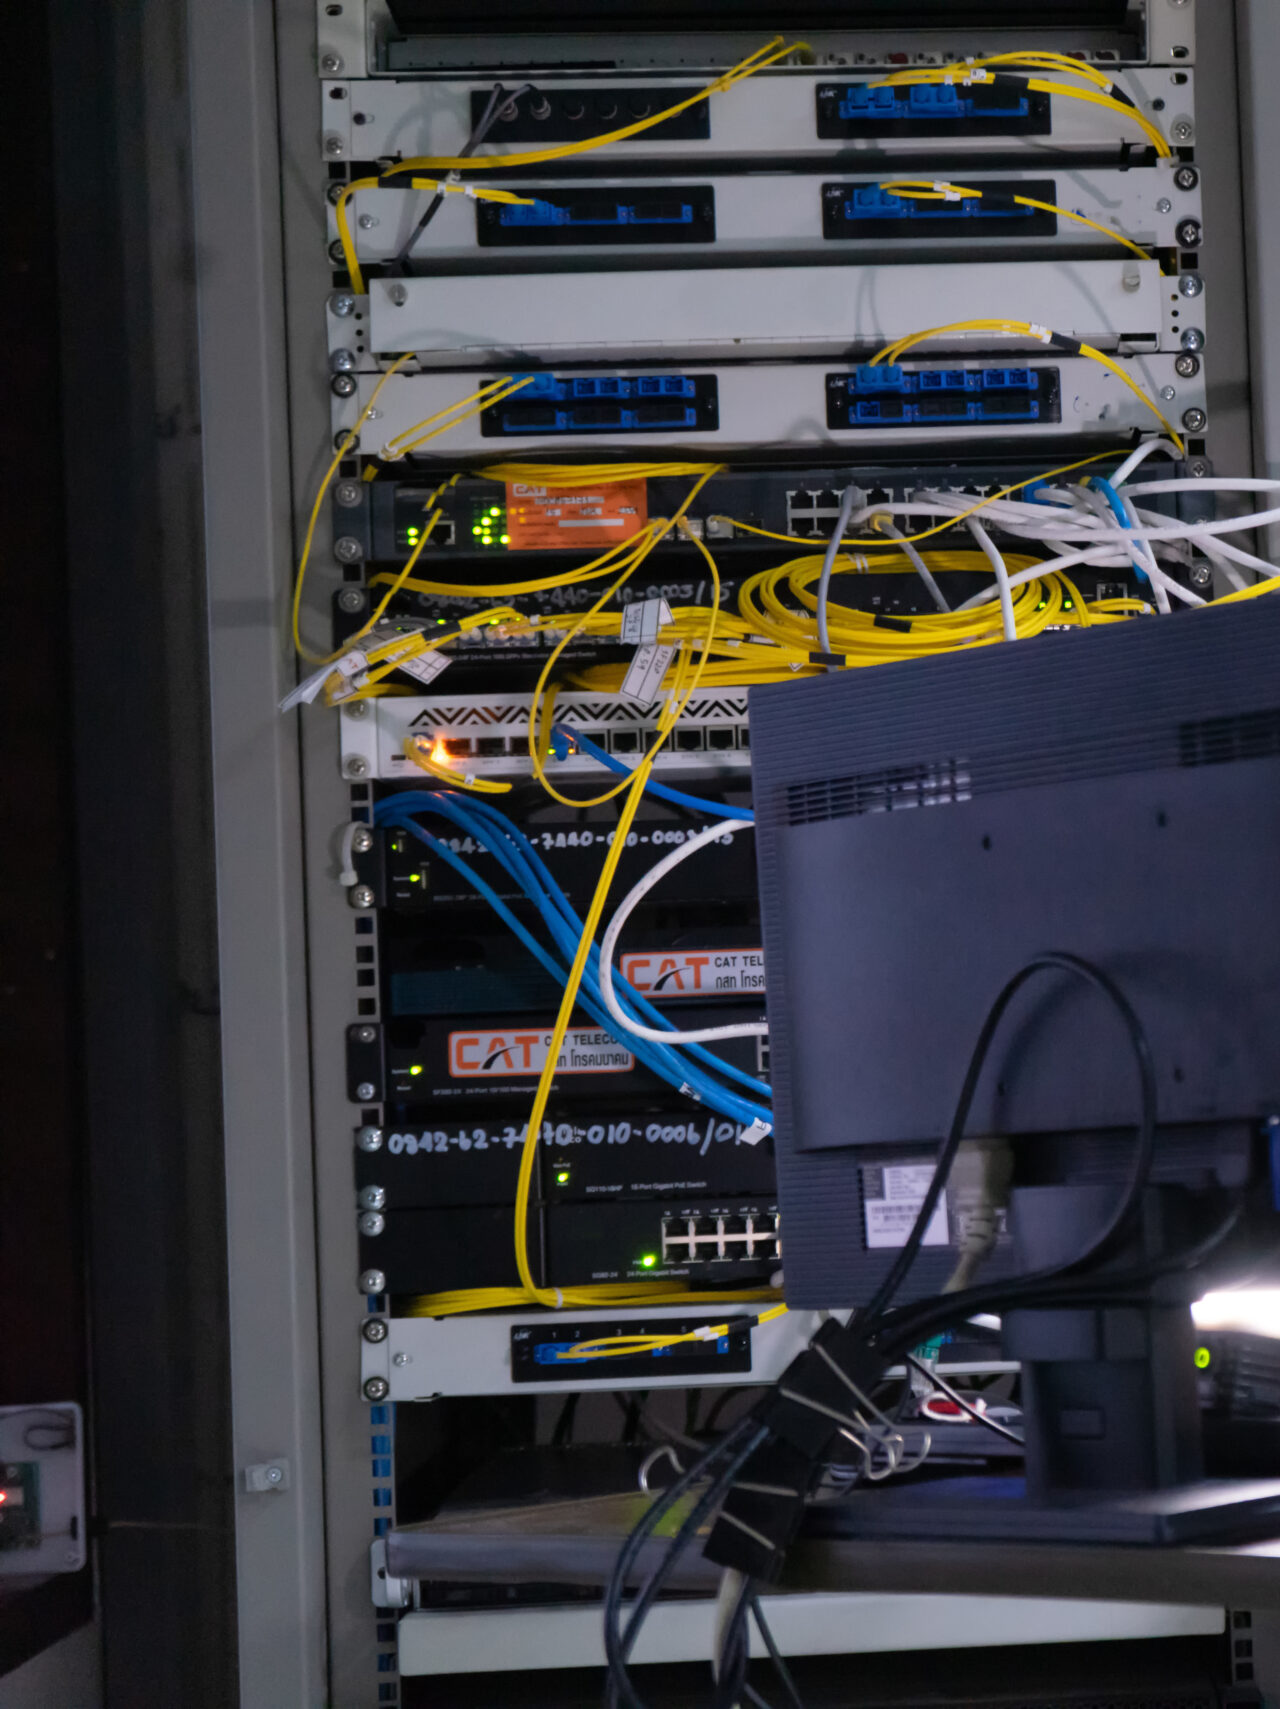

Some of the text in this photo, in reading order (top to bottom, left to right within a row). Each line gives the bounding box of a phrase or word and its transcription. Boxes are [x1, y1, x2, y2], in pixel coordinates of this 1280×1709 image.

[627, 957, 710, 991] CAT
[714, 956, 738, 967] CAT
[455, 1035, 540, 1070] CAT
[544, 1035, 568, 1047] CT
